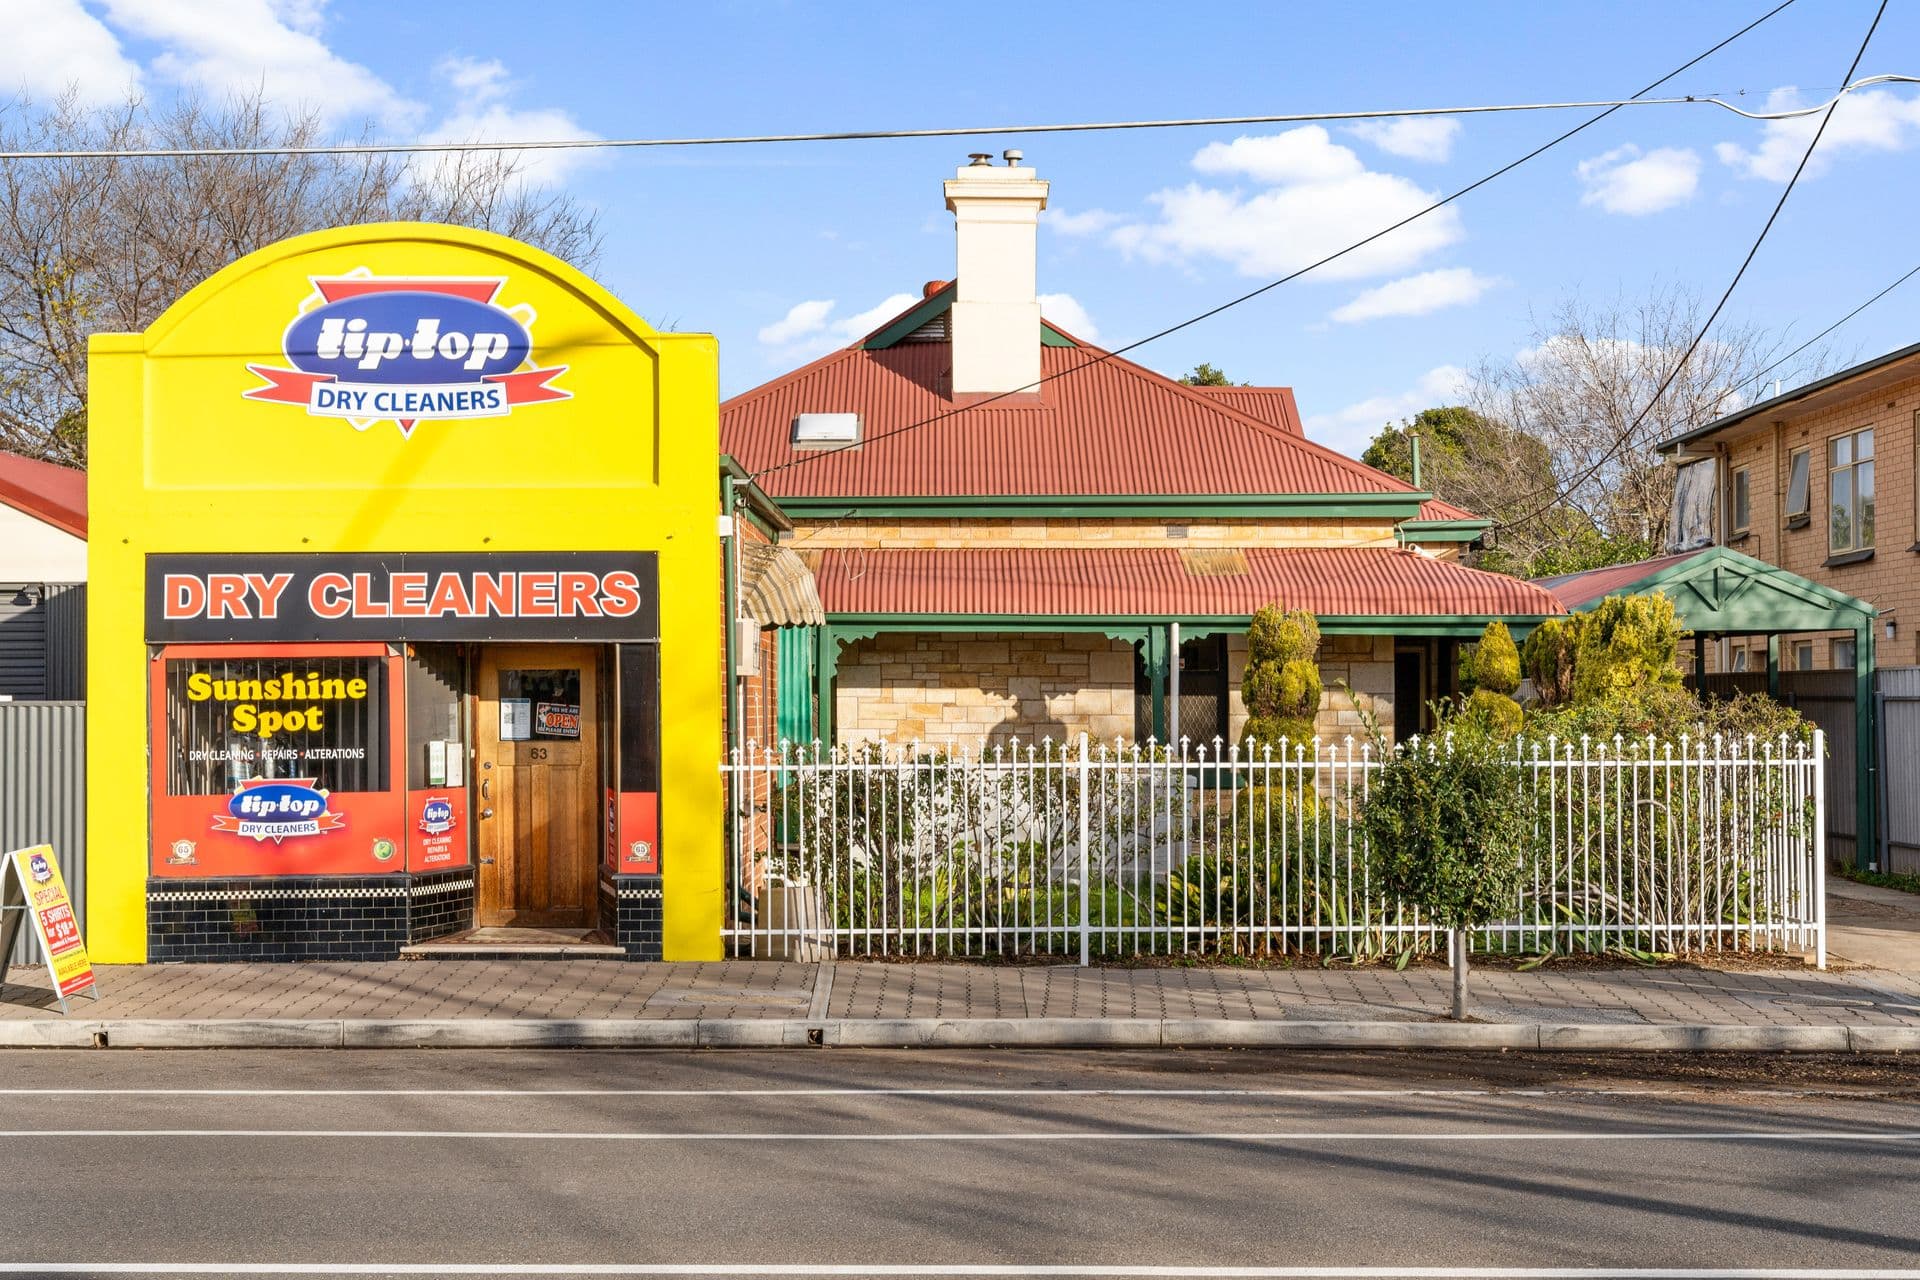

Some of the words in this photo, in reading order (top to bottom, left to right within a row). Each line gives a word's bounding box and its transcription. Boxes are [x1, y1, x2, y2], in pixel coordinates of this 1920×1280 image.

[317, 388, 368, 411] DRY
[374, 389, 500, 412] CLEANERS
[163, 573, 294, 620] DRY
[307, 570, 641, 619] CLEANERS
[187, 672, 368, 701] Sunshine
[232, 704, 324, 739] Spot
[545, 712, 579, 729] OPEN
[189, 750, 208, 761] DRY
[209, 750, 254, 761] CLEANING
[261, 749, 298, 760] REPAIRS
[304, 748, 365, 760] ALTERATIONS
[530, 748, 548, 760] 63
[241, 824, 262, 833] DRY
[264, 822, 316, 834] CLEANERS
[431, 836, 452, 845] CLEANING
[424, 853, 451, 863] ALTERATIONS
[427, 846, 445, 854] REPAIRS
[34, 886, 65, 906] SPECIAL
[40, 911, 48, 927] 5
[47, 905, 71, 923] SHIRTS
